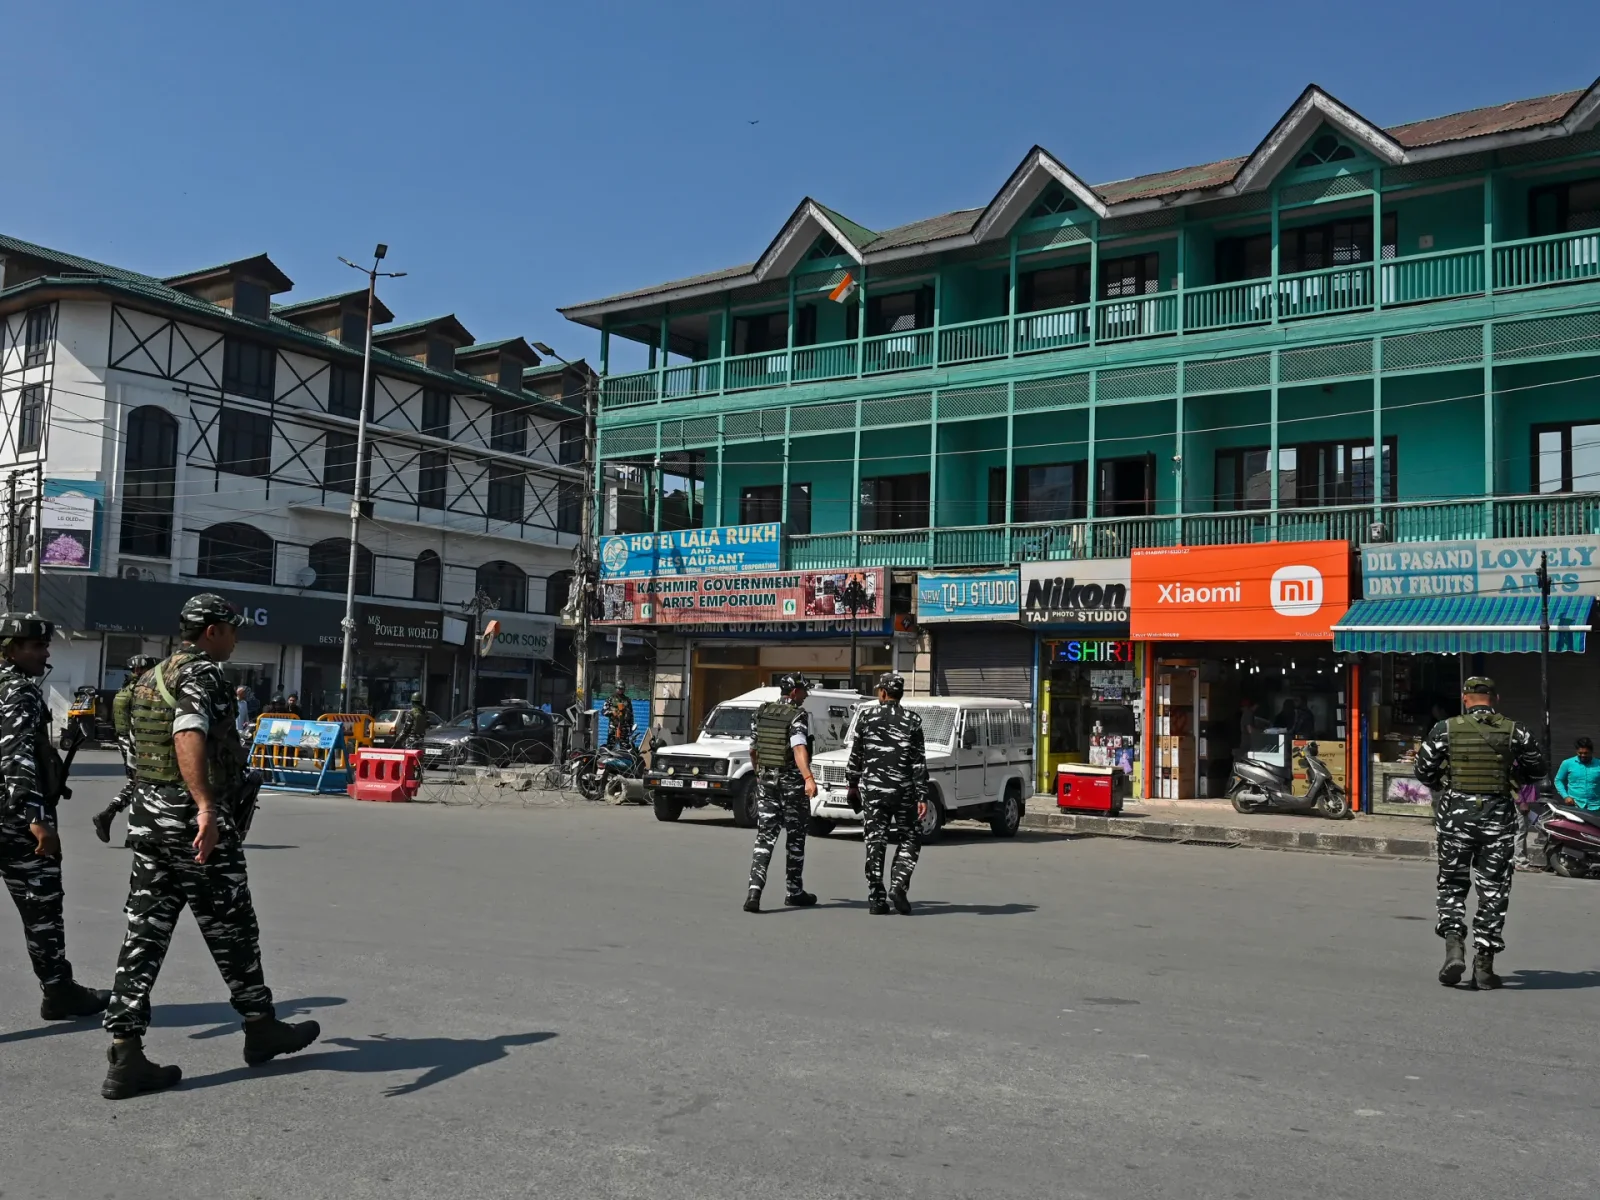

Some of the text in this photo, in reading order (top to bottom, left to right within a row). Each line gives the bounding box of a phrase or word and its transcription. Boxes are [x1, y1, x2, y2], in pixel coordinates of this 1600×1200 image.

[631, 524, 777, 552] HOTEL LALA RUKH
[658, 552, 745, 568] RESTAURANT
[690, 547, 712, 556] AND
[1367, 549, 1474, 572] DIL PASAND
[1480, 546, 1597, 569] LOVELY
[741, 562, 777, 571] CORPORATION
[637, 575, 801, 594] KASHMIR GOVERNMENT
[1025, 577, 1127, 608] Nikon
[1157, 581, 1241, 603] Xiaomi
[1368, 574, 1474, 595] DRY FRUITS
[1499, 572, 1580, 594] ARTS
[662, 593, 776, 609] ARTS EMPORIUM
[920, 580, 1017, 613] NEW TAJ STUDIO
[367, 615, 381, 625] M/S
[1026, 611, 1049, 622] TAJ
[1077, 610, 1128, 622] STUDIO
[319, 635, 358, 645] BEST SOP
[375, 624, 439, 640] POWER WORLD
[521, 634, 547, 648] SONS
[1046, 641, 1133, 662] T-SHIRT
